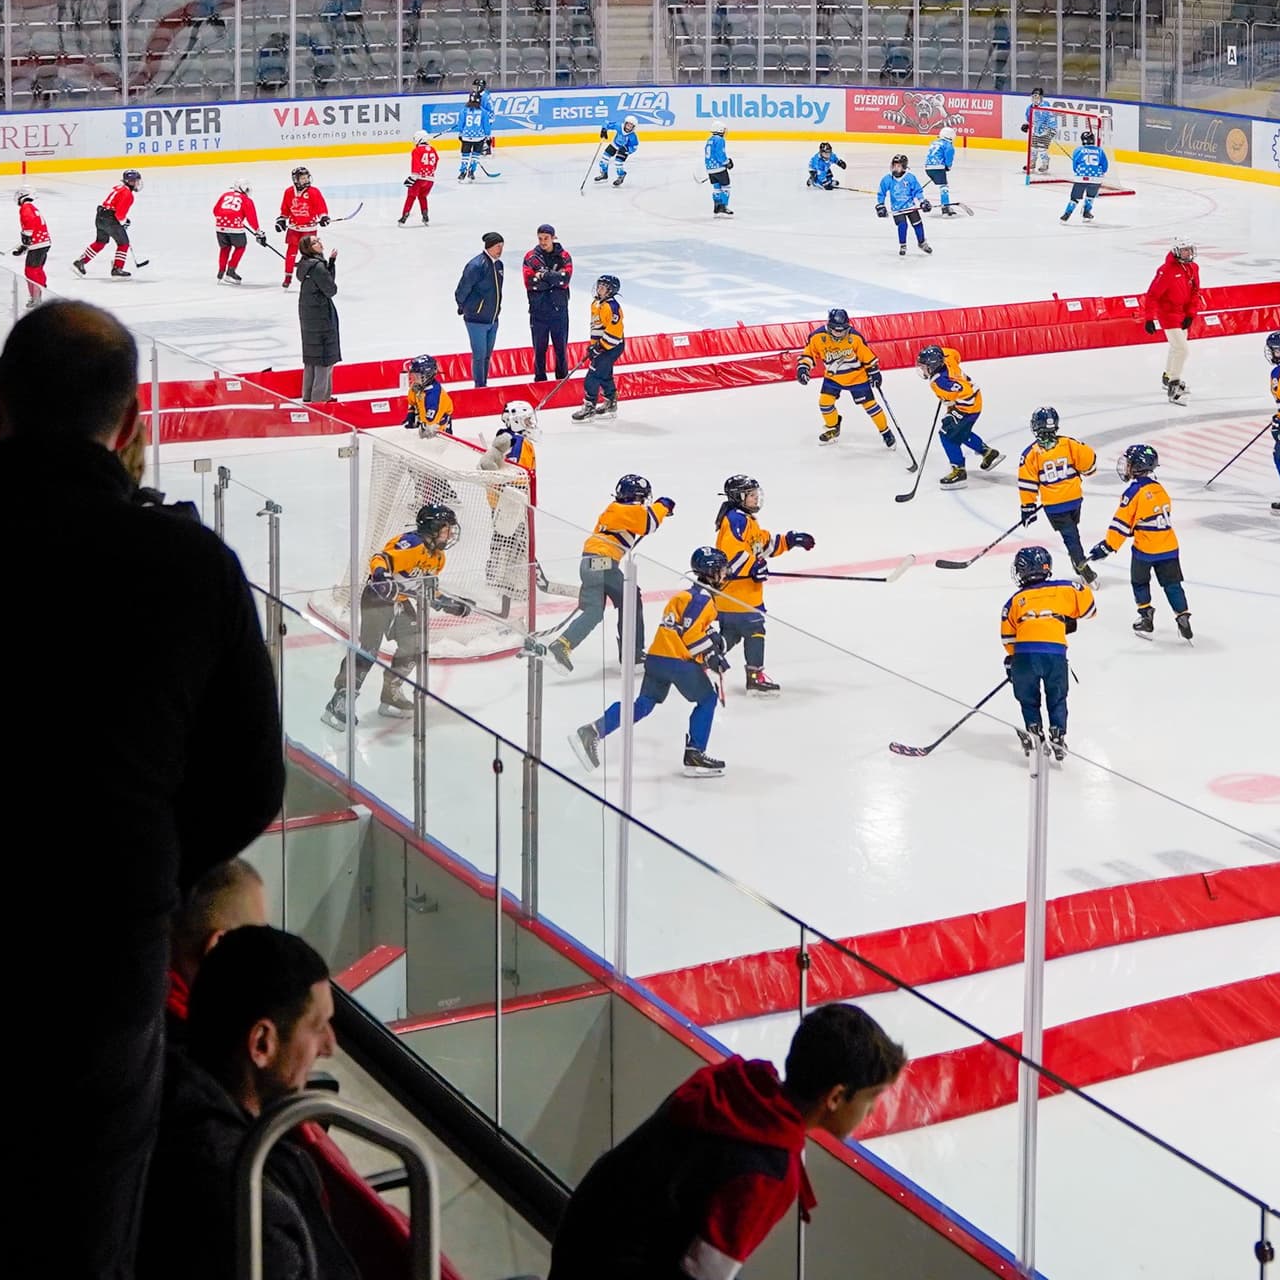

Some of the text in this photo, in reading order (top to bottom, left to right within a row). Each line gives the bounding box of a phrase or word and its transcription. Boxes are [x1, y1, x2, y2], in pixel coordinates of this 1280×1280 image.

[617, 91, 667, 111] LIGA
[696, 93, 831, 125] Lullababy
[854, 93, 994, 110] GYERGYÓI HOKI KLUB
[273, 103, 401, 128] VIASTEIN
[430, 112, 460, 126] ERST
[465, 114, 482, 127] 64
[553, 106, 593, 119] ERSTE
[123, 107, 221, 138] BAYER
[0, 123, 79, 150] RELY
[281, 128, 401, 141] transforming the space
[126, 137, 221, 154] PROPERTY
[421, 152, 436, 166] 43
[1043, 457, 1068, 483] 87
